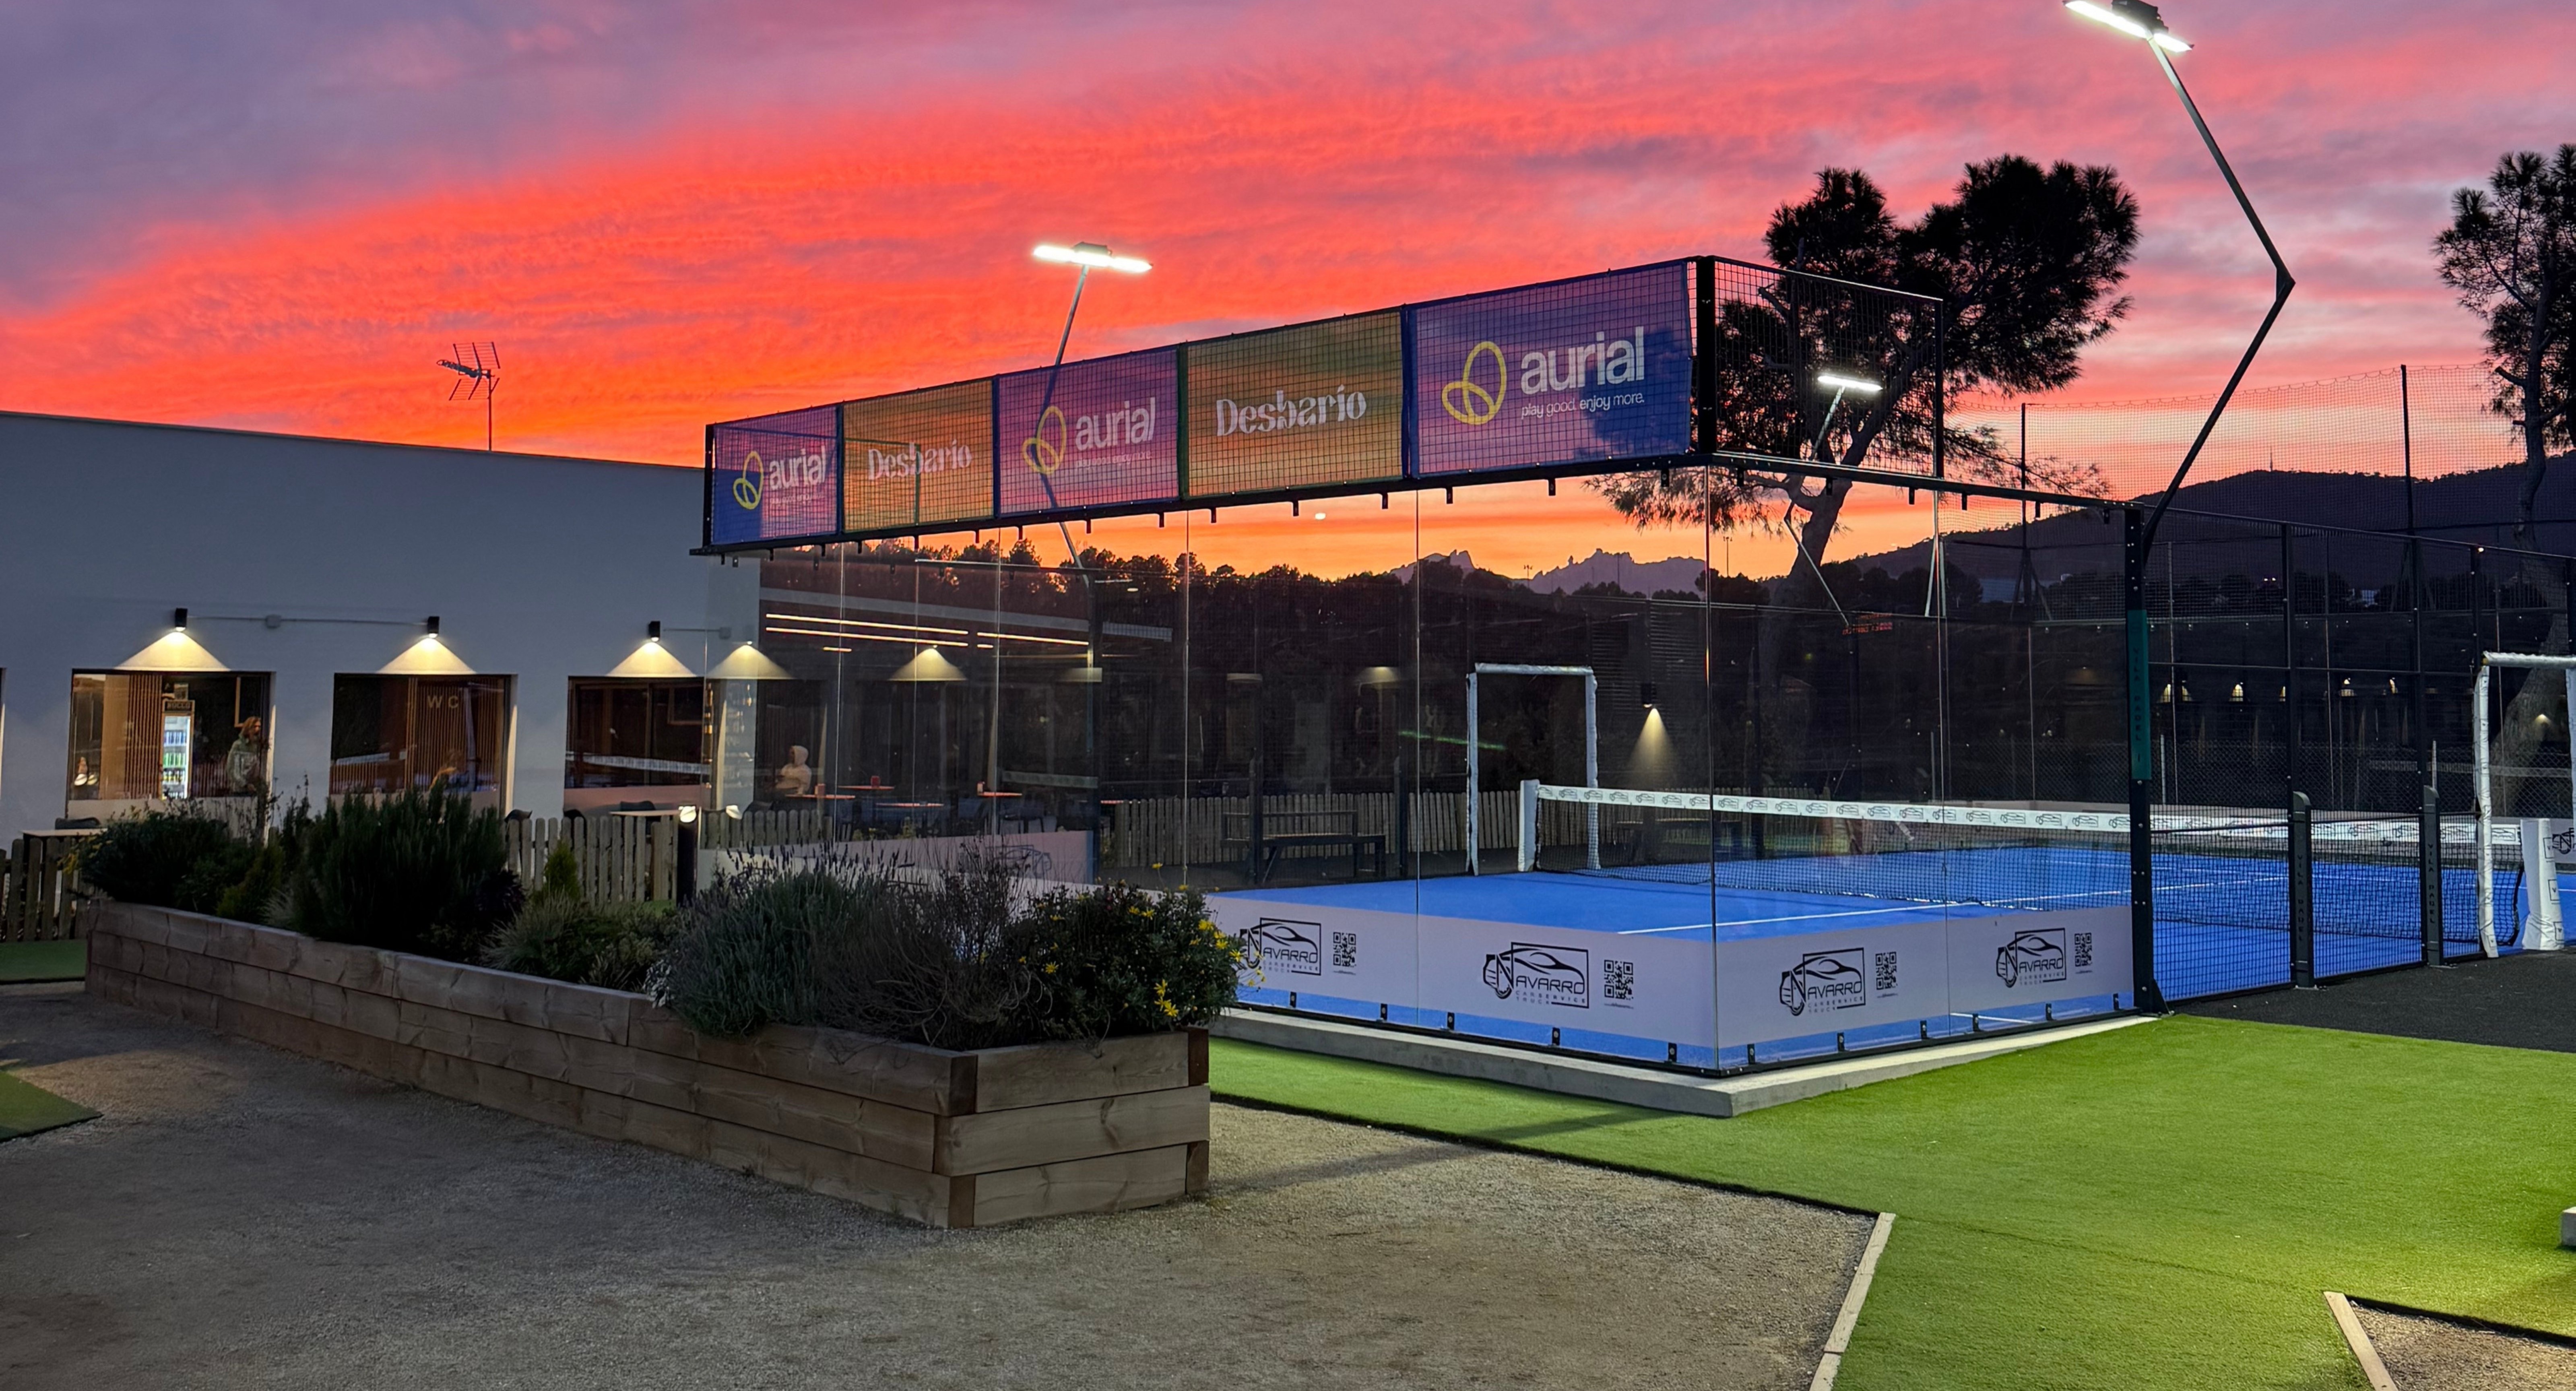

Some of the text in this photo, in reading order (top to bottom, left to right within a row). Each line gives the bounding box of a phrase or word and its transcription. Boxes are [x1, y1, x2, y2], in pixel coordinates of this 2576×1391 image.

[1521, 326, 1645, 395] aurial
[1075, 397, 1156, 451] aurial
[1521, 403, 1544, 420] play
[1579, 395, 1610, 413] enjoy
[1613, 392, 1645, 406] more.
[769, 445, 825, 491] aurial
[427, 695, 459, 708] WC
